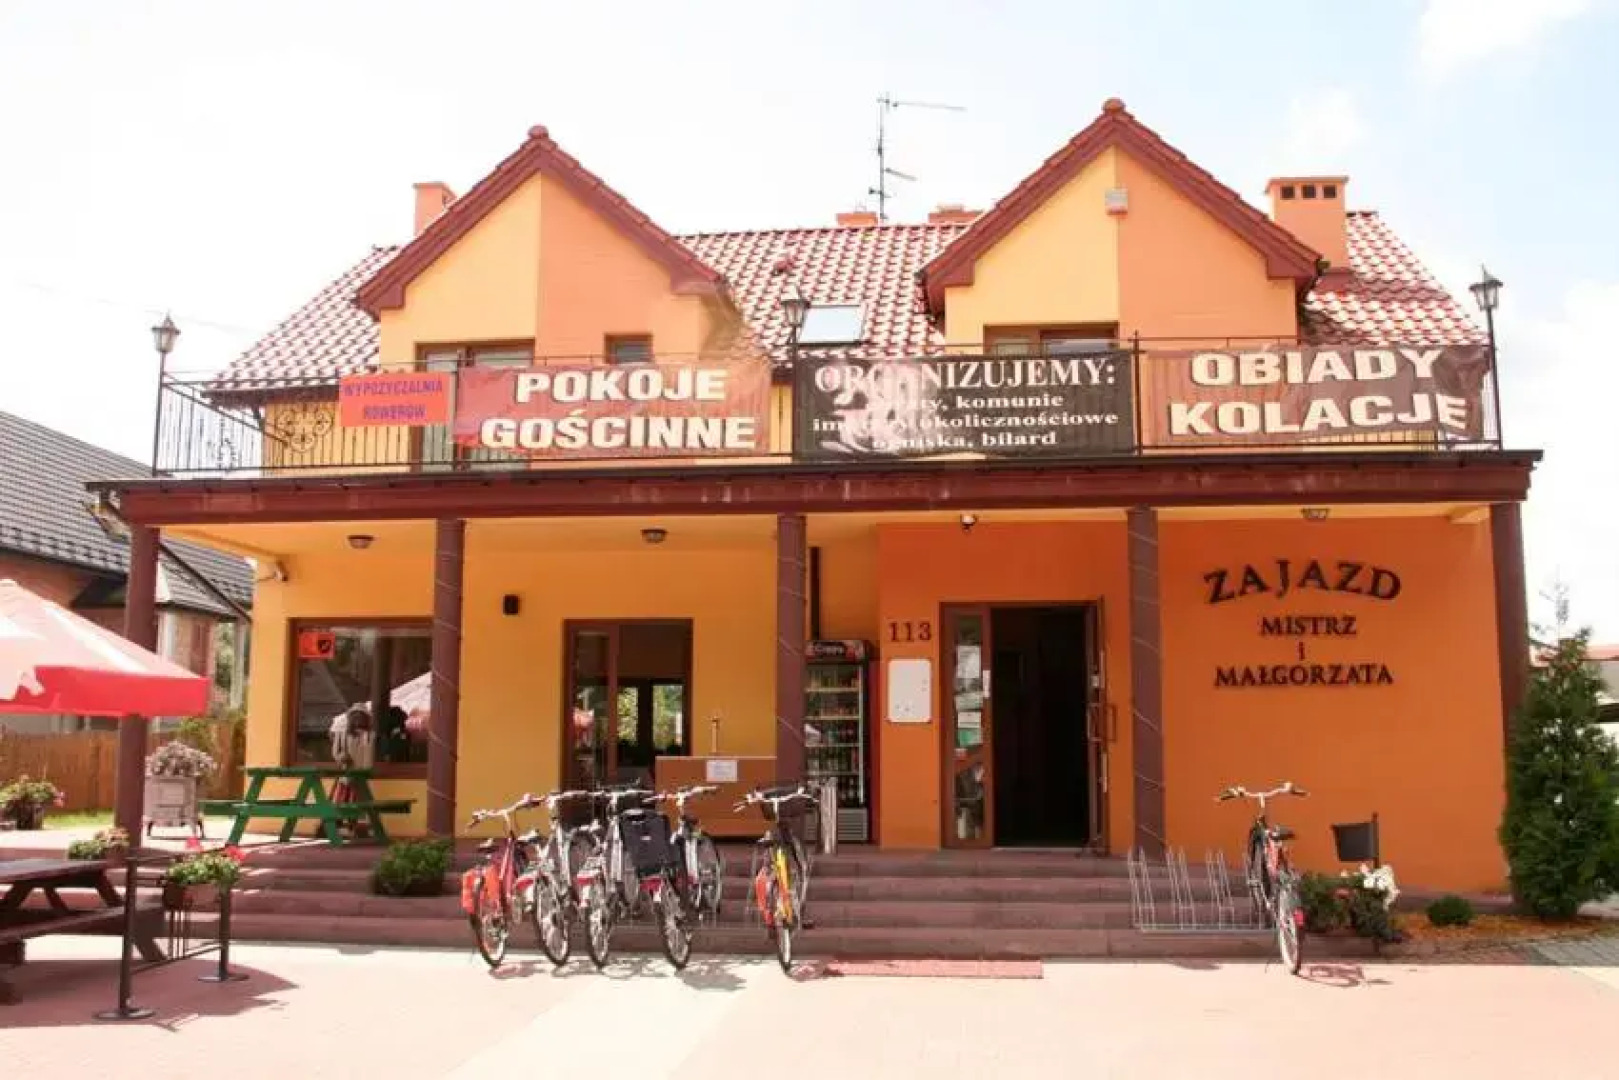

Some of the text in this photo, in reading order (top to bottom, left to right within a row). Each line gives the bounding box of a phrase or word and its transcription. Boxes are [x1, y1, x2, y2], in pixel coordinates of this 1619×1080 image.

[1191, 350, 1442, 386] OBIADY
[516, 368, 727, 402] POKOJE
[955, 392, 1064, 409] komunie
[1169, 394, 1467, 435] KOLACJE
[480, 409, 756, 449] GOŚCINNE
[873, 430, 1058, 450] oniska, bilard
[1203, 559, 1402, 604] ZAJAZD
[889, 622, 932, 642] 113
[1261, 616, 1357, 635] MISTRZ
[1298, 641, 1305, 660] i
[1215, 664, 1393, 686] MAŁGORZATA
